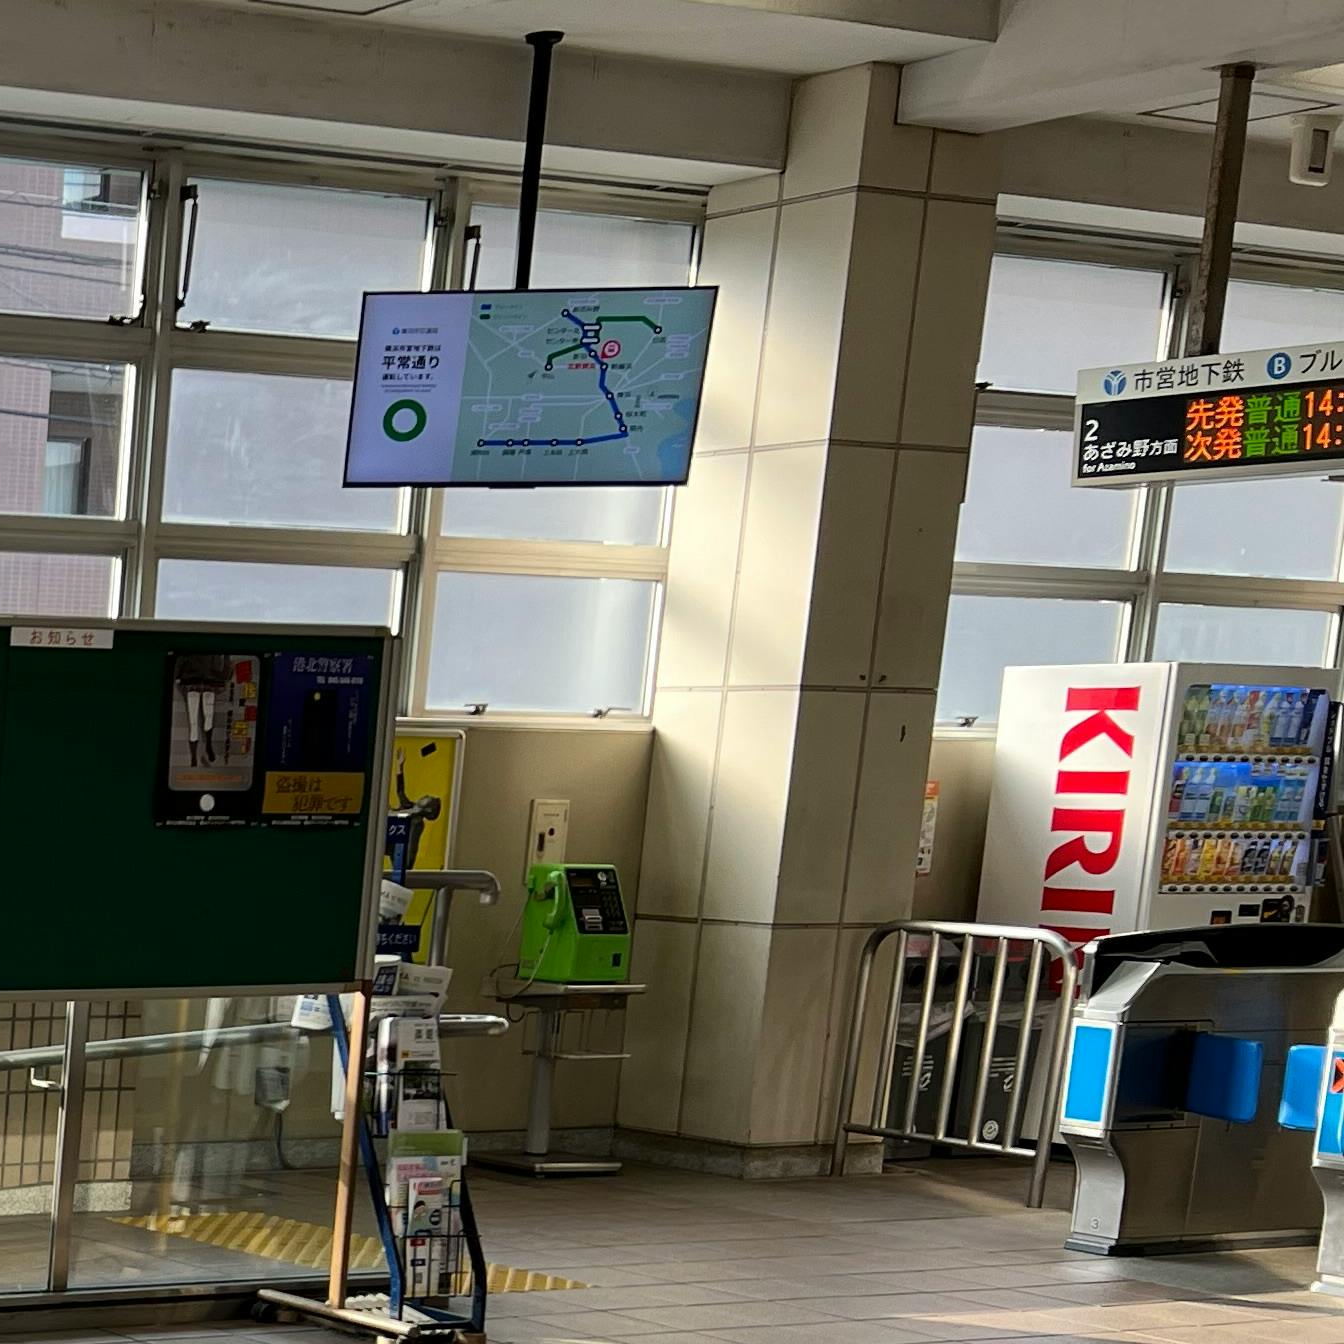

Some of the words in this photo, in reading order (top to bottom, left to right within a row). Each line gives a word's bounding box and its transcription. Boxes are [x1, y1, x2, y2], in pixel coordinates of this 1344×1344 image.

[381, 355, 440, 370] 平常通り
[1274, 356, 1286, 374] B
[1300, 349, 1343, 374] ブル
[1134, 359, 1245, 393] 市営地下鉄
[1186, 395, 1244, 431] 先発
[1244, 390, 1302, 424] 普通
[1084, 419, 1100, 442] 2
[1083, 438, 1179, 462] あざみ野方面
[1184, 427, 1242, 464] 次発
[1242, 424, 1300, 458] 普通
[1082, 463, 1096, 474] for
[1098, 461, 1136, 473] Azamino
[30, 629, 96, 647] お知らせ
[376, 932, 417, 946] ちください
[1090, 1218, 1100, 1230] 3
